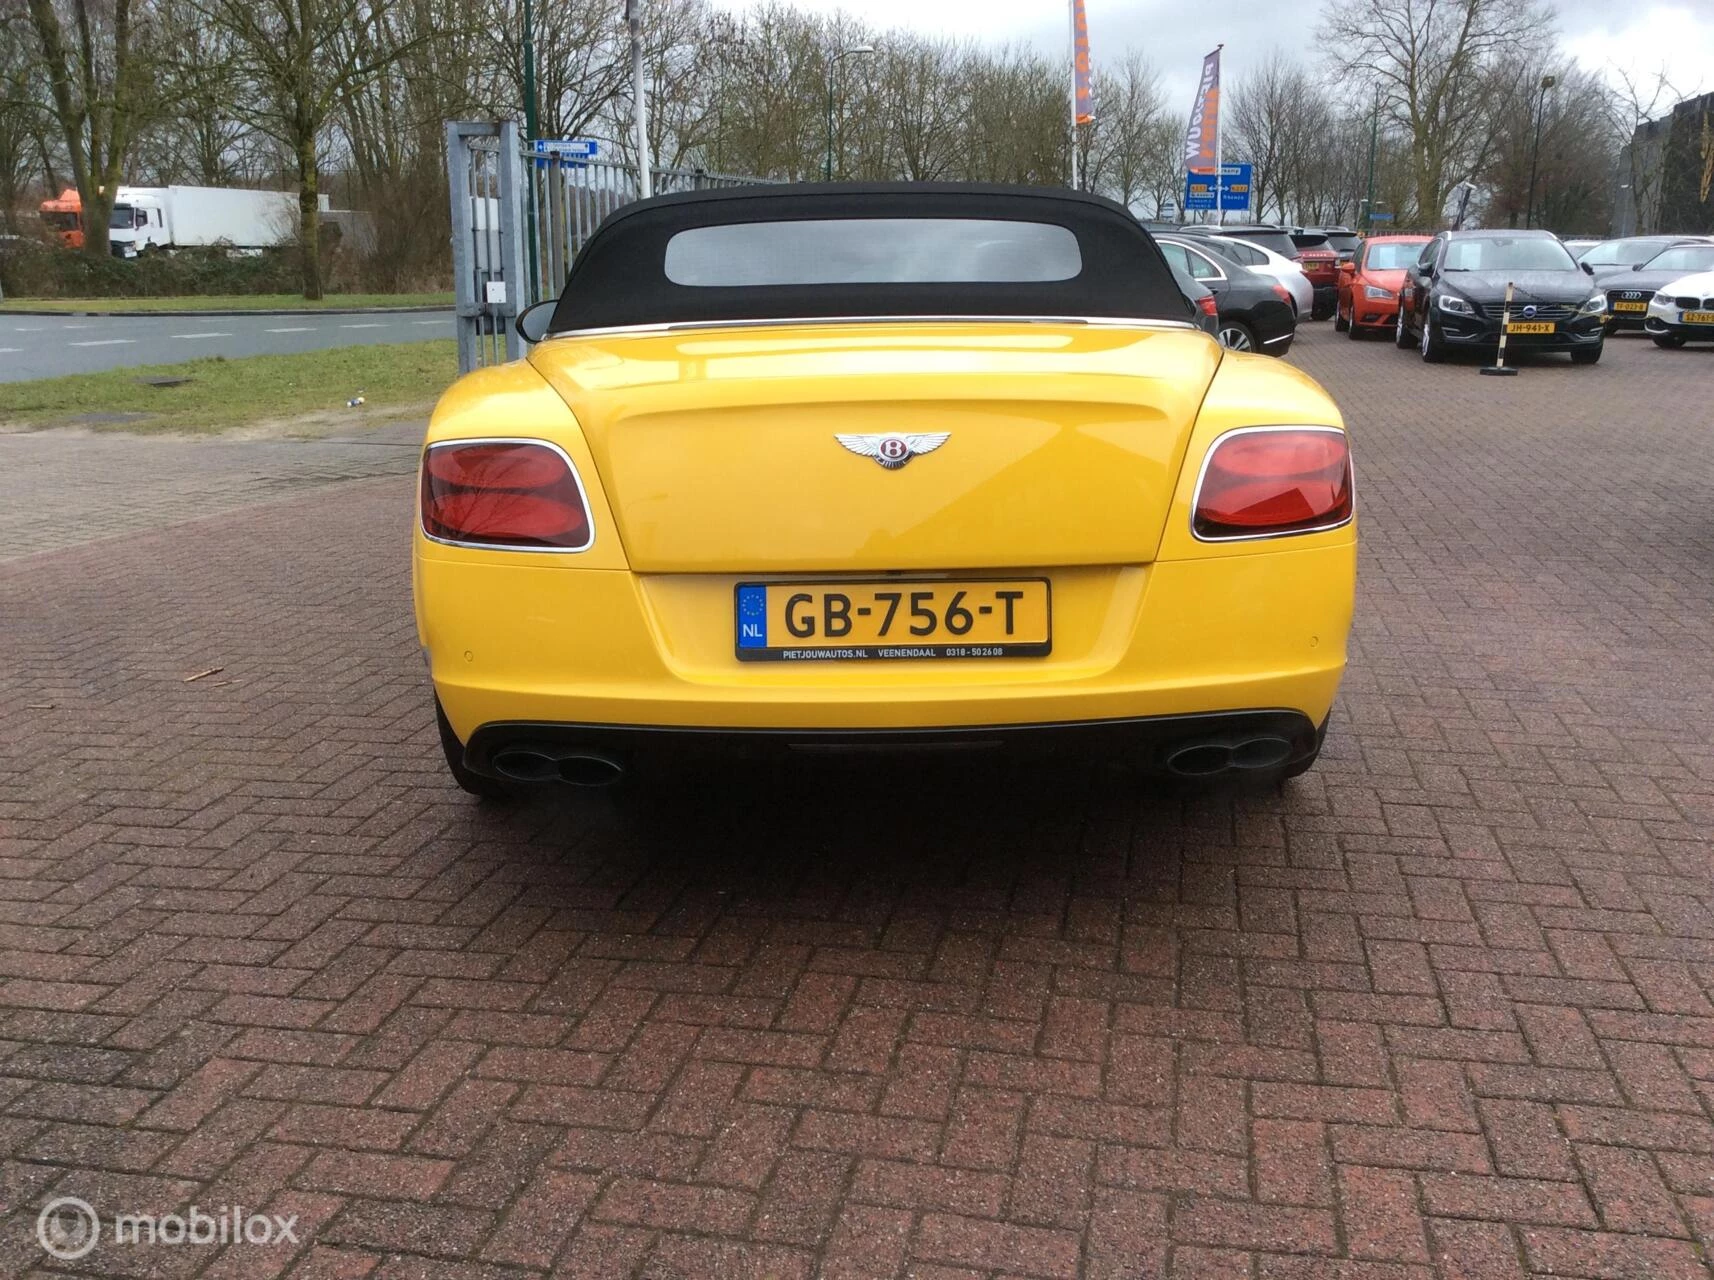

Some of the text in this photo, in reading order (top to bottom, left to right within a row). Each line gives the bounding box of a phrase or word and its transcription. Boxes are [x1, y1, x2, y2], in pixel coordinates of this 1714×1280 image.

[1511, 324, 1550, 332] JH-941-X
[885, 440, 902, 456] B
[784, 591, 1023, 637] GB-756-T
[743, 623, 762, 637] NL
[783, 649, 868, 658] PIETJOUWAUTOS.NL
[878, 648, 936, 657] VEENENDAAL
